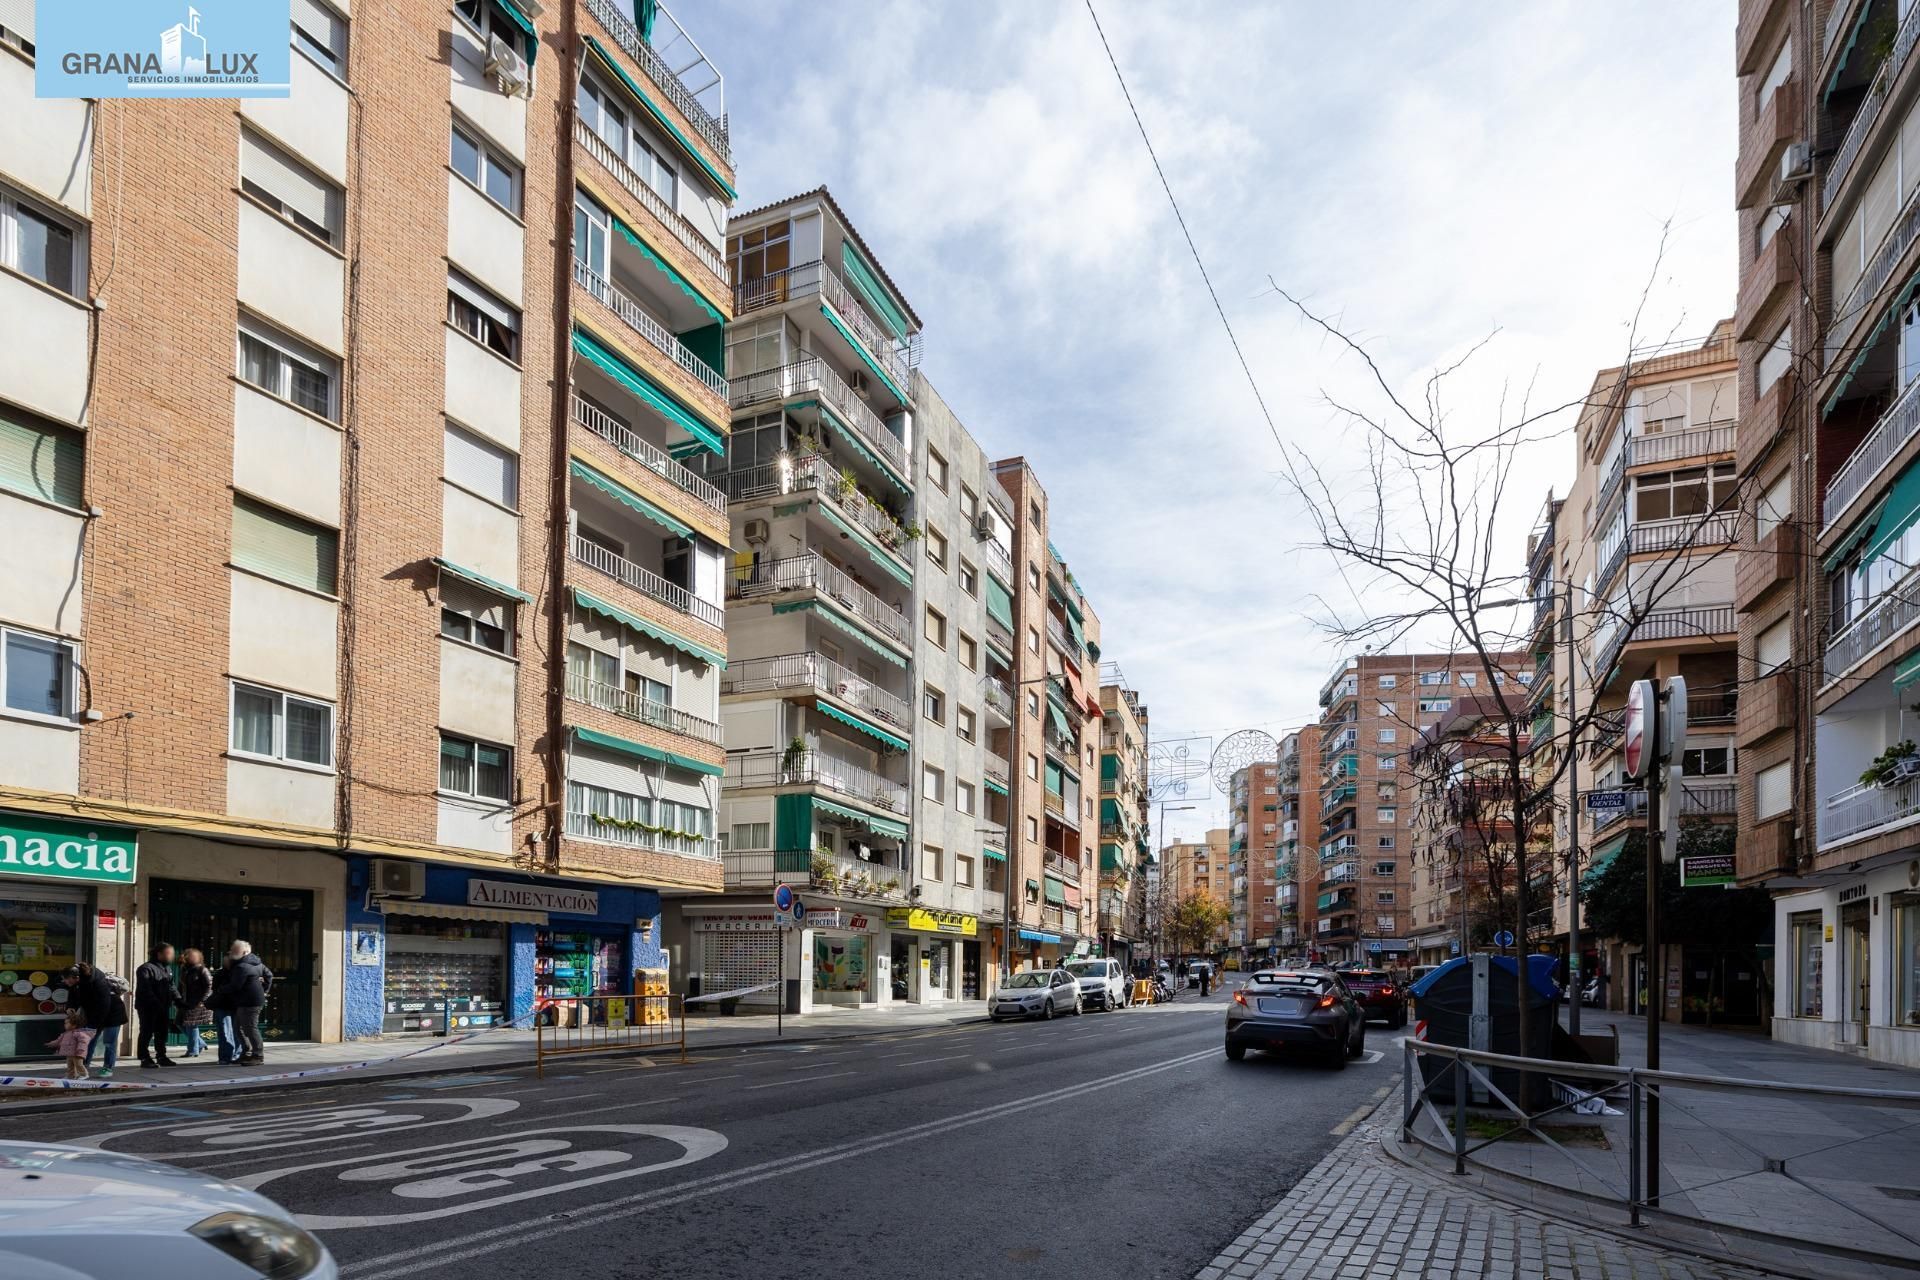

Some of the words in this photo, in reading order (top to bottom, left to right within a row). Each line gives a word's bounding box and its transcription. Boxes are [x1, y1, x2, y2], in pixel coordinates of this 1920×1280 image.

[1591, 799, 1622, 807] DENTAL
[1687, 867, 1734, 877] MANOLO
[242, 894, 250, 906] 9
[473, 881, 597, 912] ALIMENTACIÓN
[337, 1139, 633, 1199] 30
